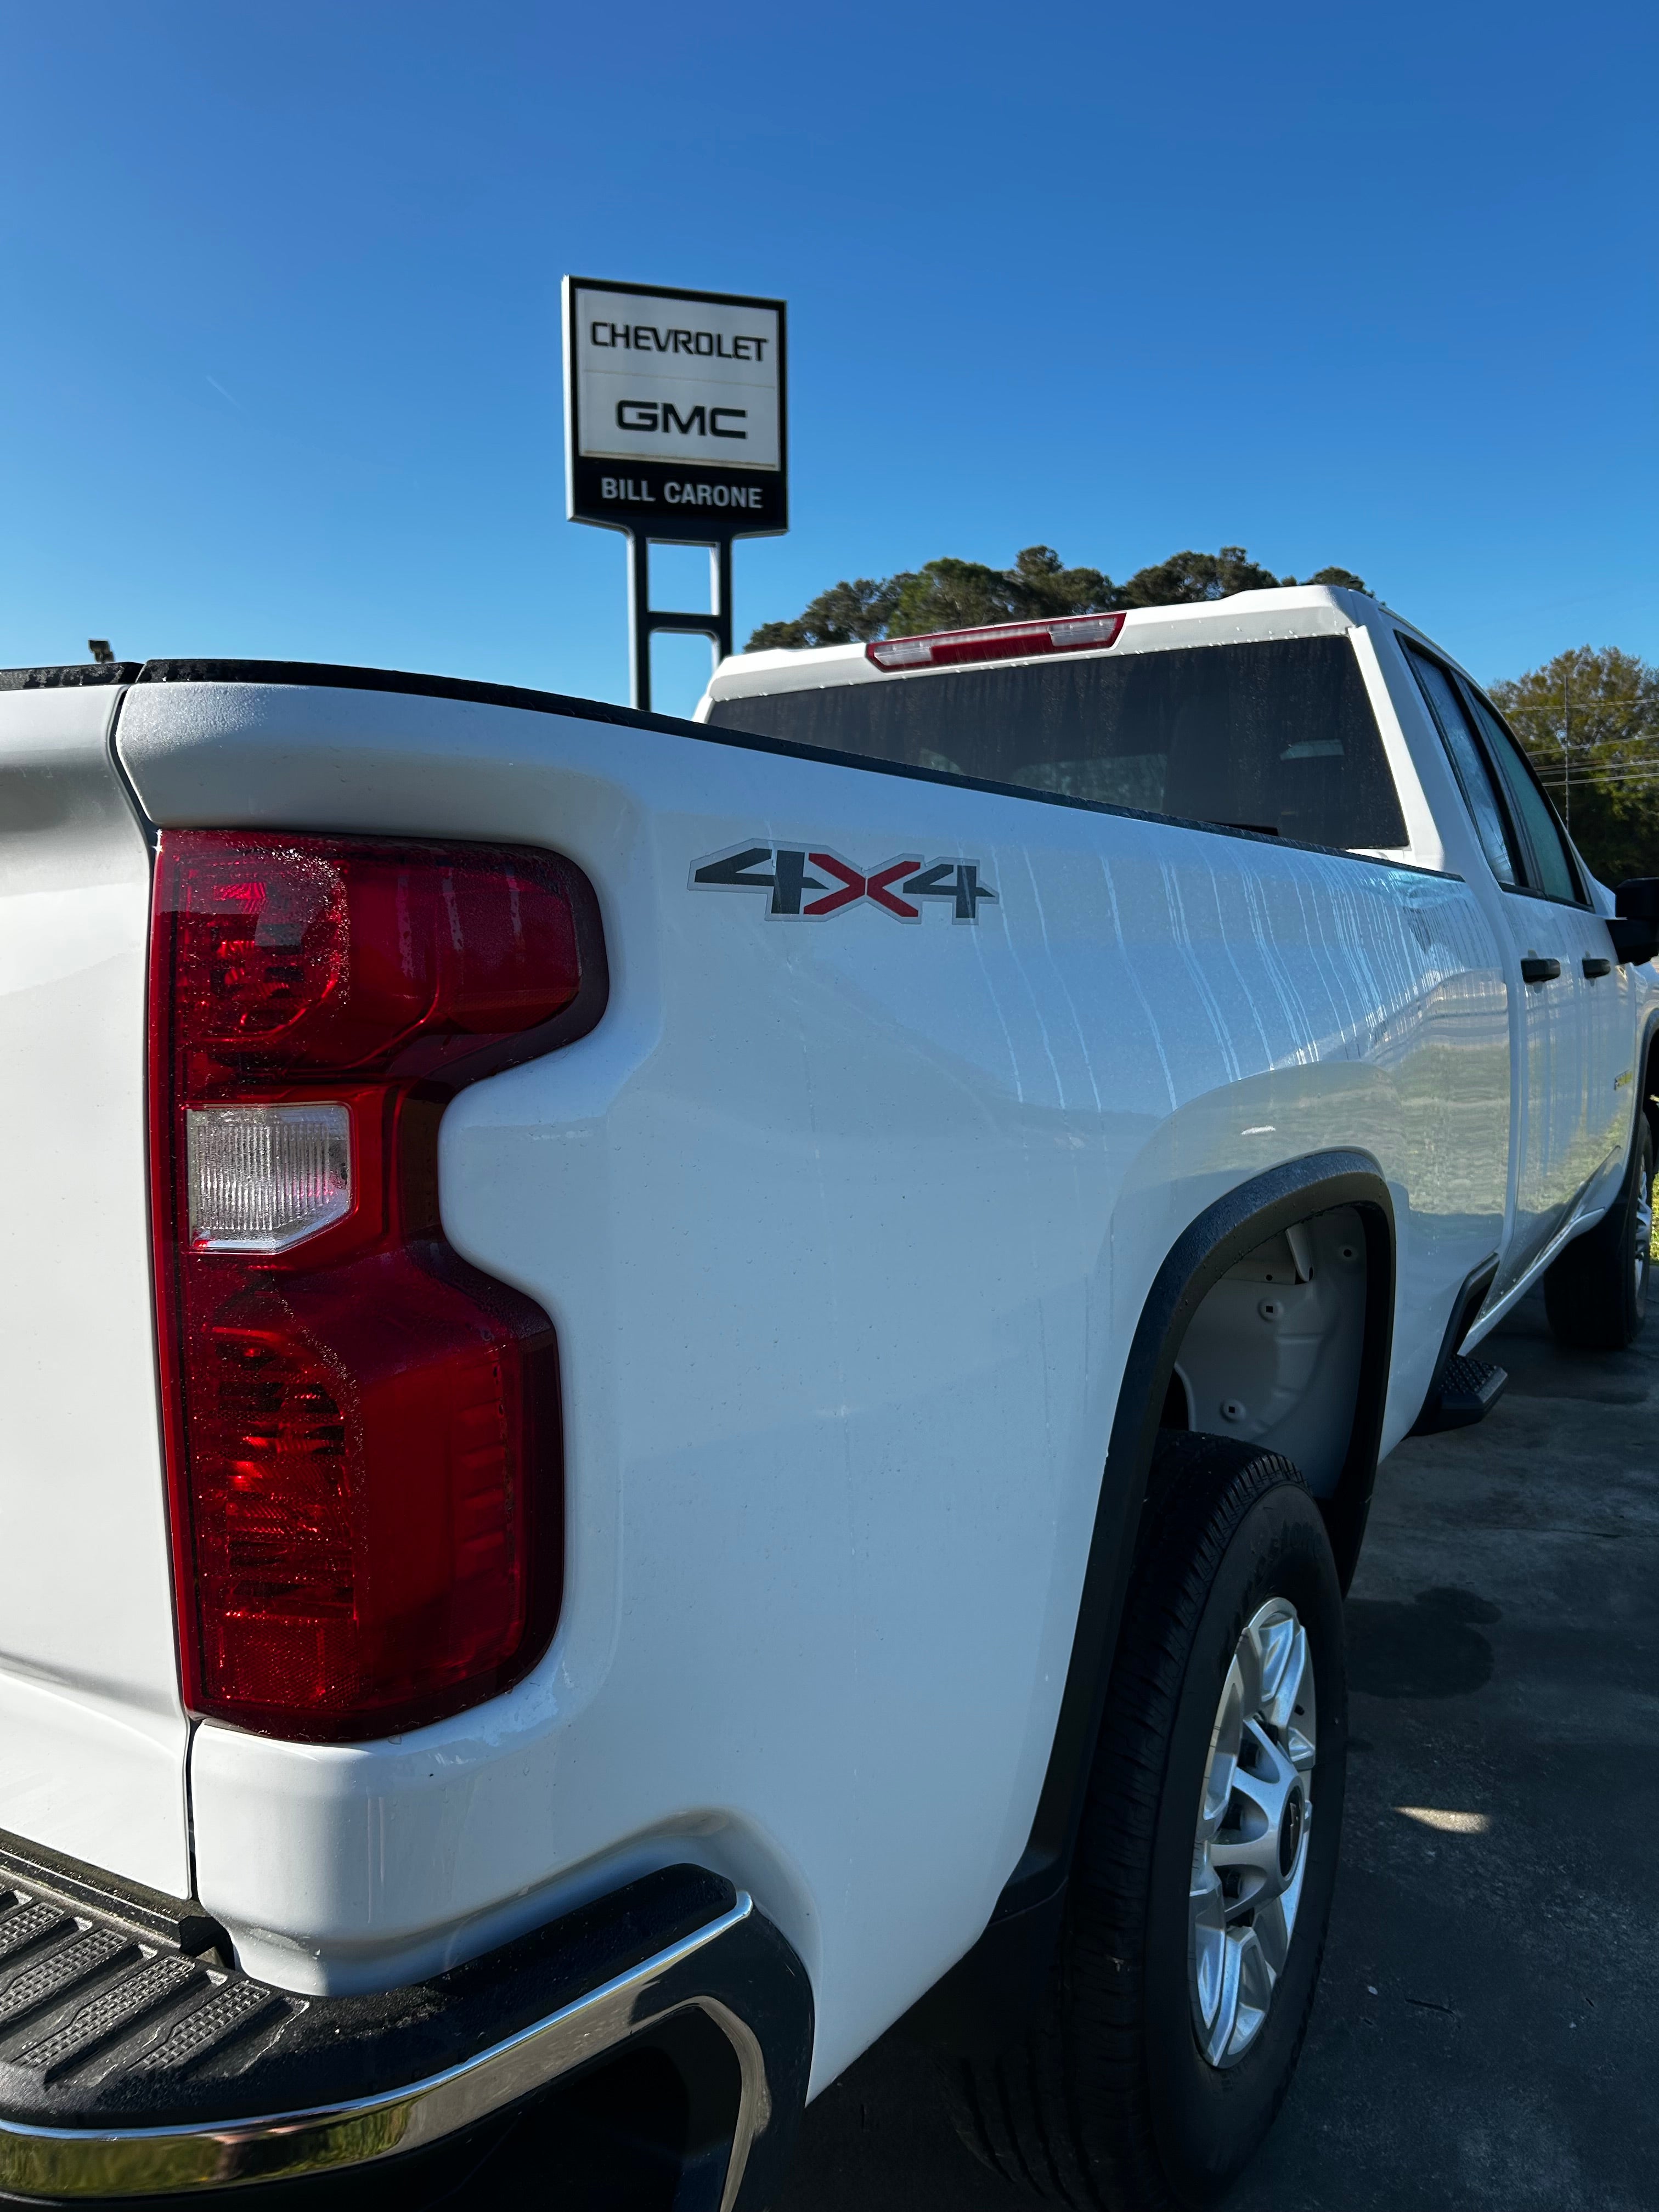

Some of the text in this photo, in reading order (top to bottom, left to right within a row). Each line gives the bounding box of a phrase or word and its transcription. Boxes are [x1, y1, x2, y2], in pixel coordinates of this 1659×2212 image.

[591, 321, 768, 362] CHEVROLET
[617, 400, 747, 439] GMC
[601, 477, 763, 509] BILL CARONE
[693, 848, 996, 919] 4X4
